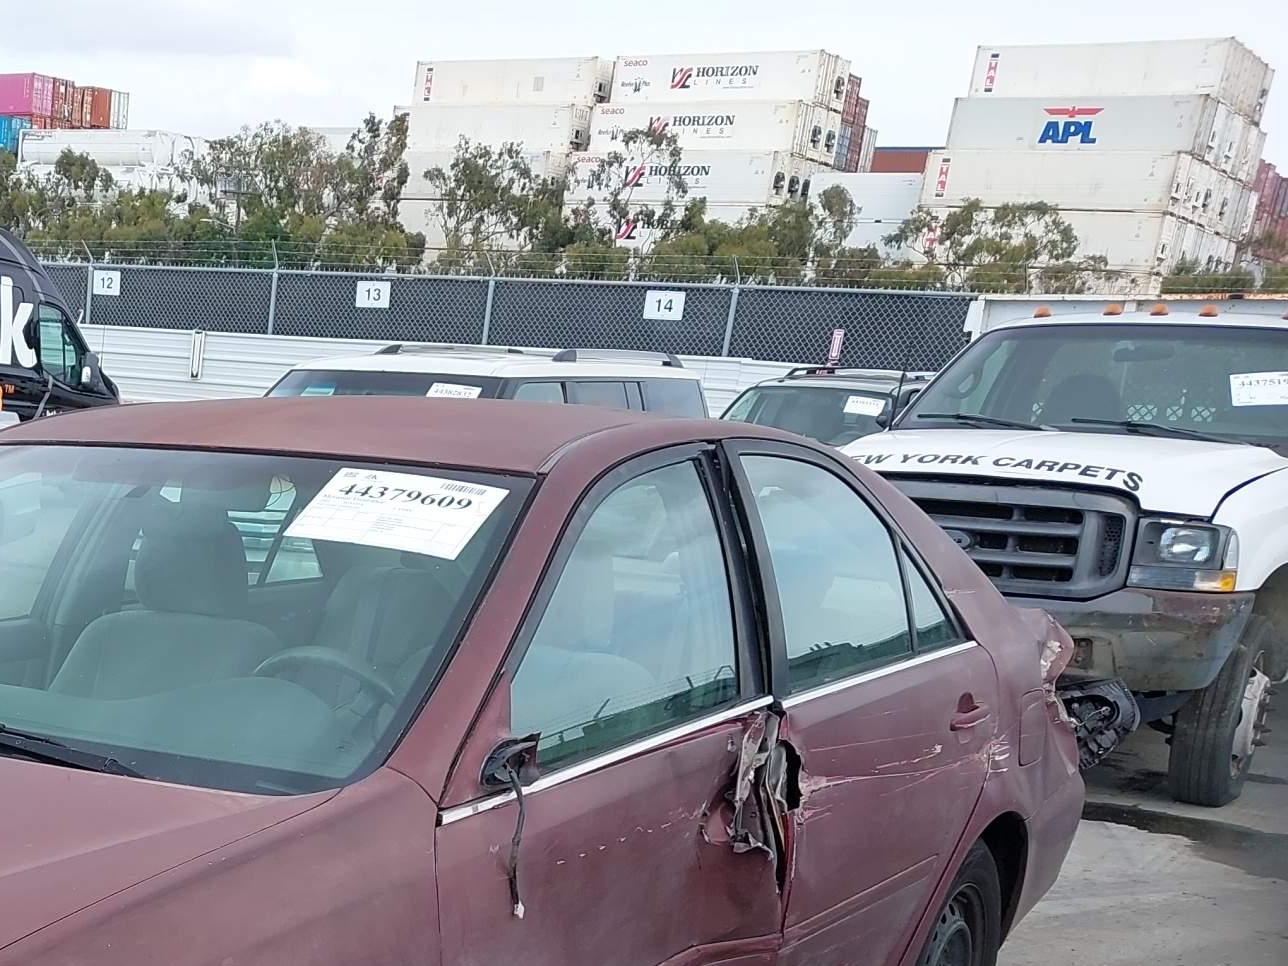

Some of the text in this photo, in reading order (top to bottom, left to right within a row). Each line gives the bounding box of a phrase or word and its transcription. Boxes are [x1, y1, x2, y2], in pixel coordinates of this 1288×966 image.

[623, 59, 648, 67] seaco
[695, 65, 759, 78] HORIZON
[693, 78, 748, 86] LINES
[600, 107, 625, 115] seaco
[672, 115, 736, 127] HORIZON
[1037, 120, 1097, 144] APL
[100, 276, 114, 290] 12
[364, 287, 382, 302] 13
[655, 298, 674, 313] 14
[850, 453, 1144, 492] EW YORK CARPETS
[338, 483, 474, 511] 44379609
